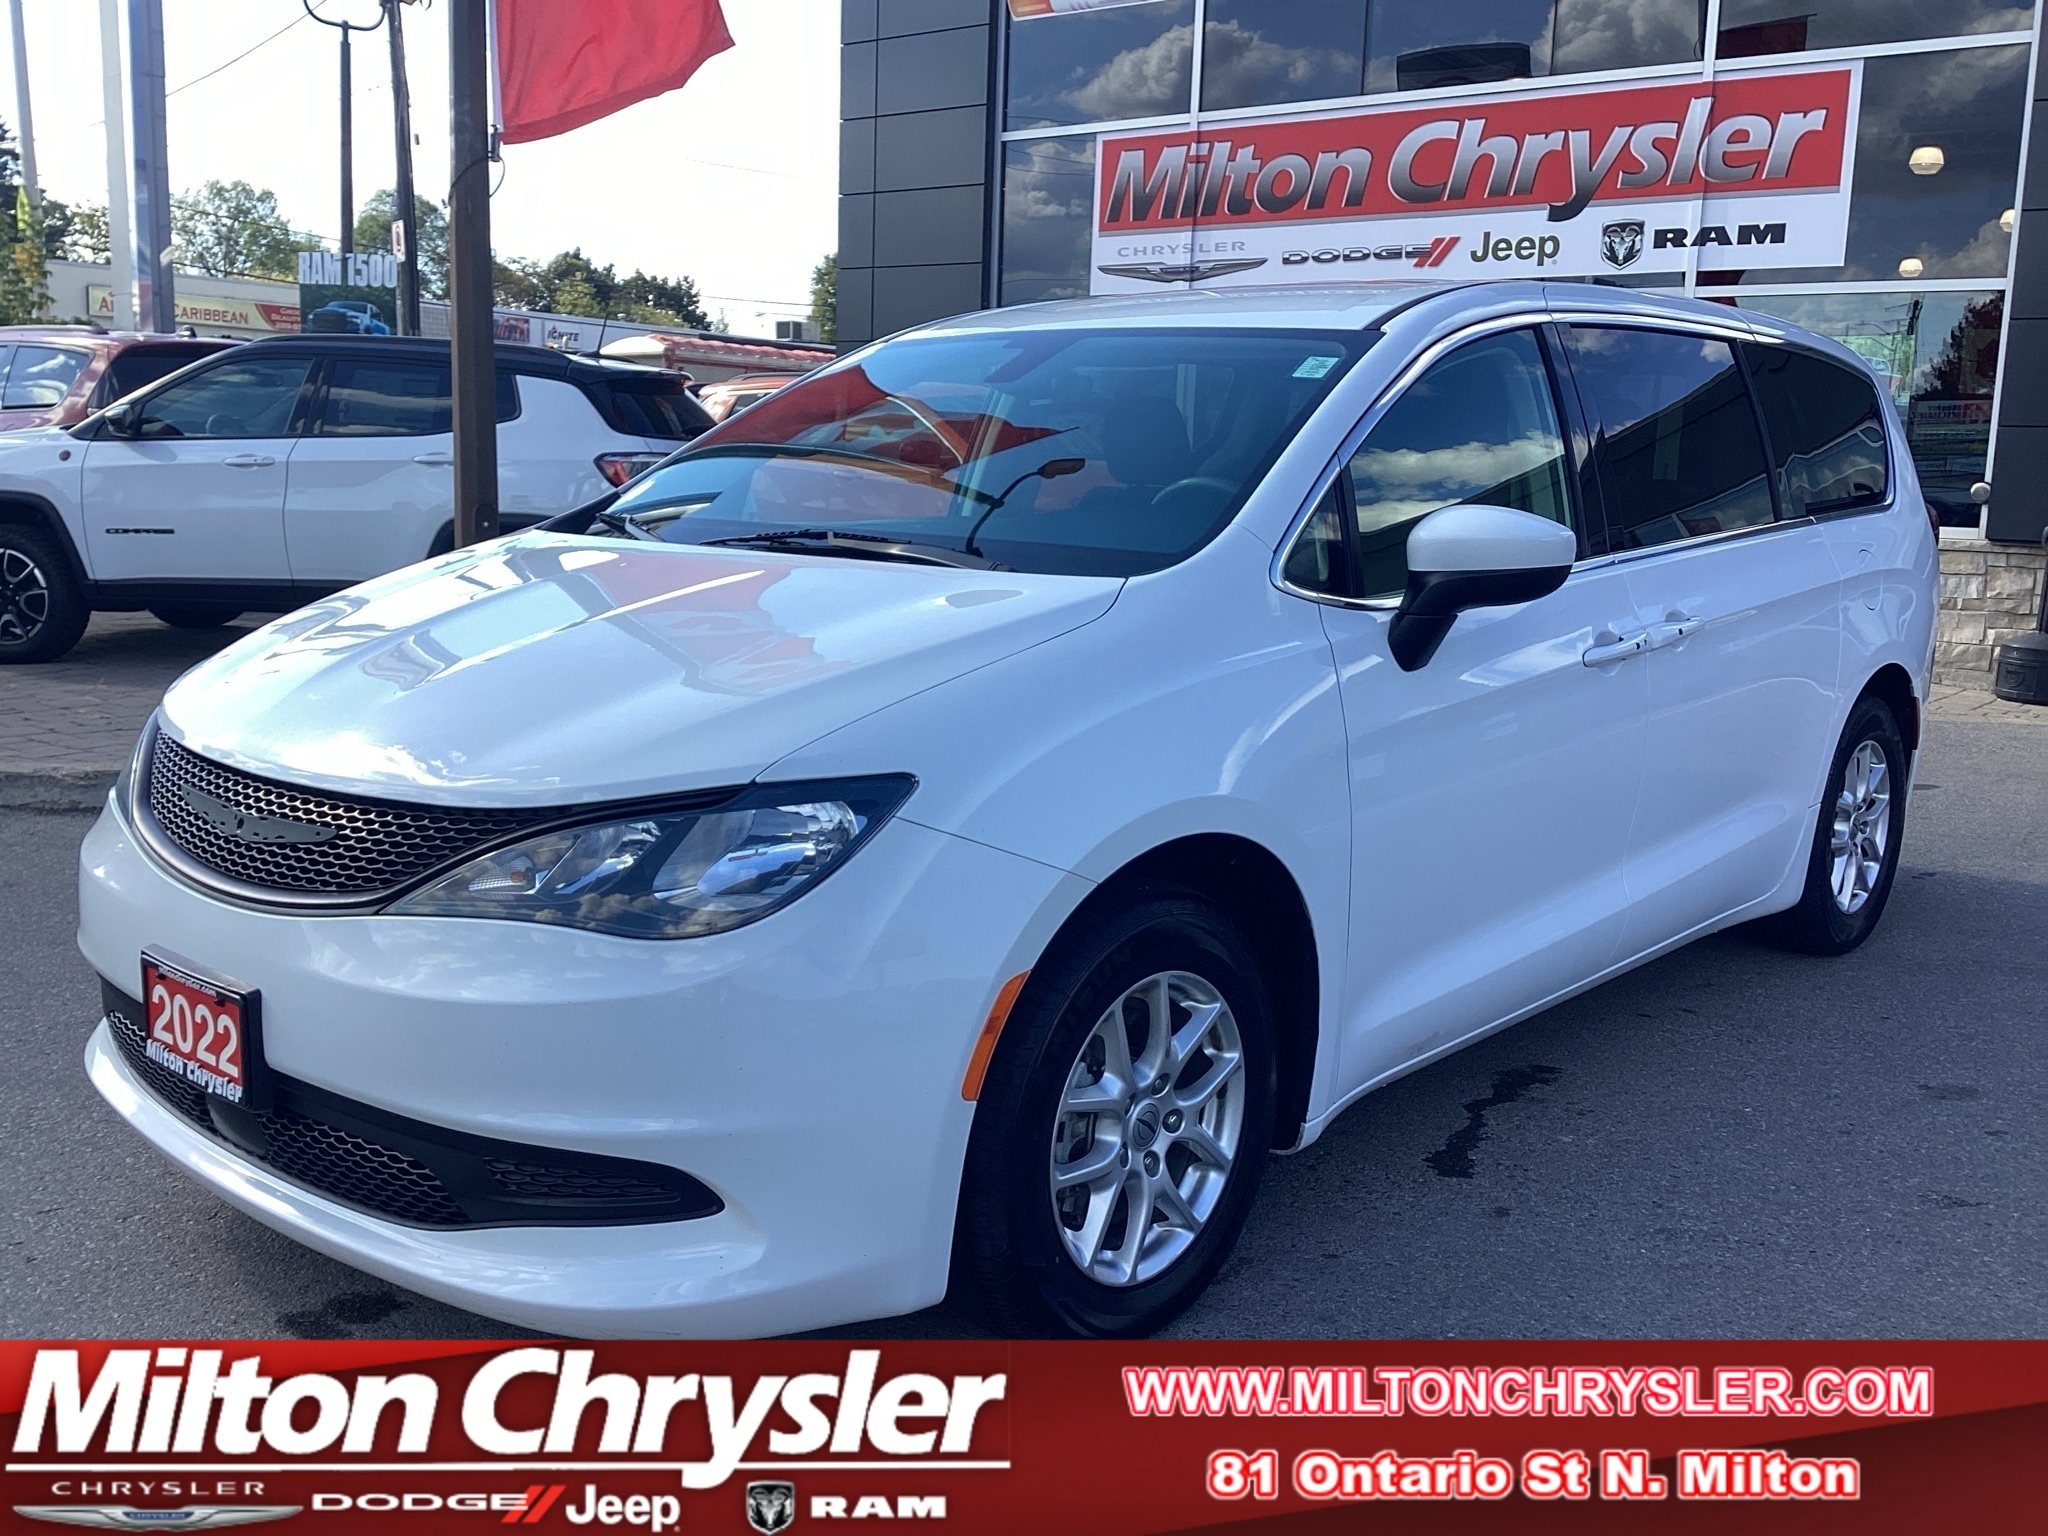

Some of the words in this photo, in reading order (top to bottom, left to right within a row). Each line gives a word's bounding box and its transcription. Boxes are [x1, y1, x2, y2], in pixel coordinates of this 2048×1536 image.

[1104, 140, 1373, 223] Milton
[1387, 96, 1828, 222] Chrysler
[1117, 240, 1246, 257] CHRYSLER
[1470, 231, 1560, 267] Jeep
[1652, 222, 1787, 249] RAM
[298, 251, 341, 285] RAM
[345, 252, 397, 288] 1500
[1281, 243, 1433, 265] DODGE
[151, 984, 239, 1078] 2022
[146, 1038, 184, 1075] Milton
